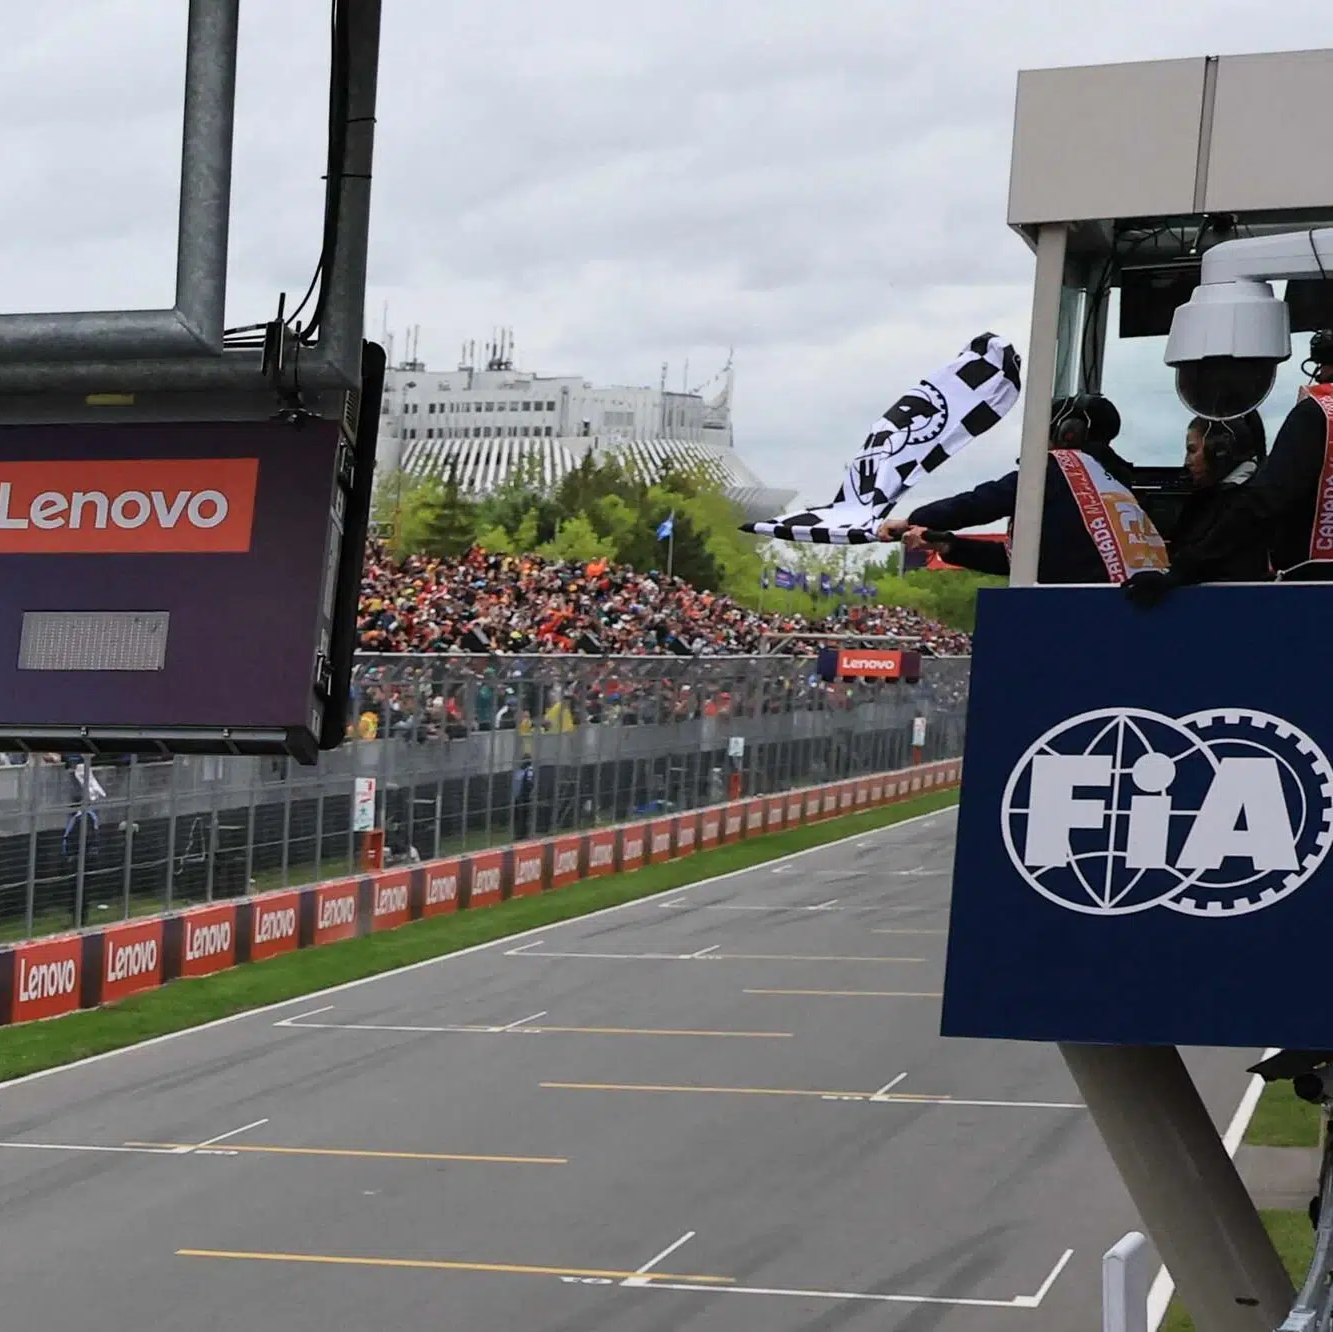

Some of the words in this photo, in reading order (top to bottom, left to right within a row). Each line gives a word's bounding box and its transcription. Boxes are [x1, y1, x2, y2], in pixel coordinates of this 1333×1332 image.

[842, 658, 895, 670] Lenovo
[254, 907, 296, 944] Lenovo
[317, 895, 355, 929] Lenovo
[185, 921, 231, 961] Lenovo
[107, 939, 157, 982] Lenovo
[20, 958, 76, 1002] Lenovo
